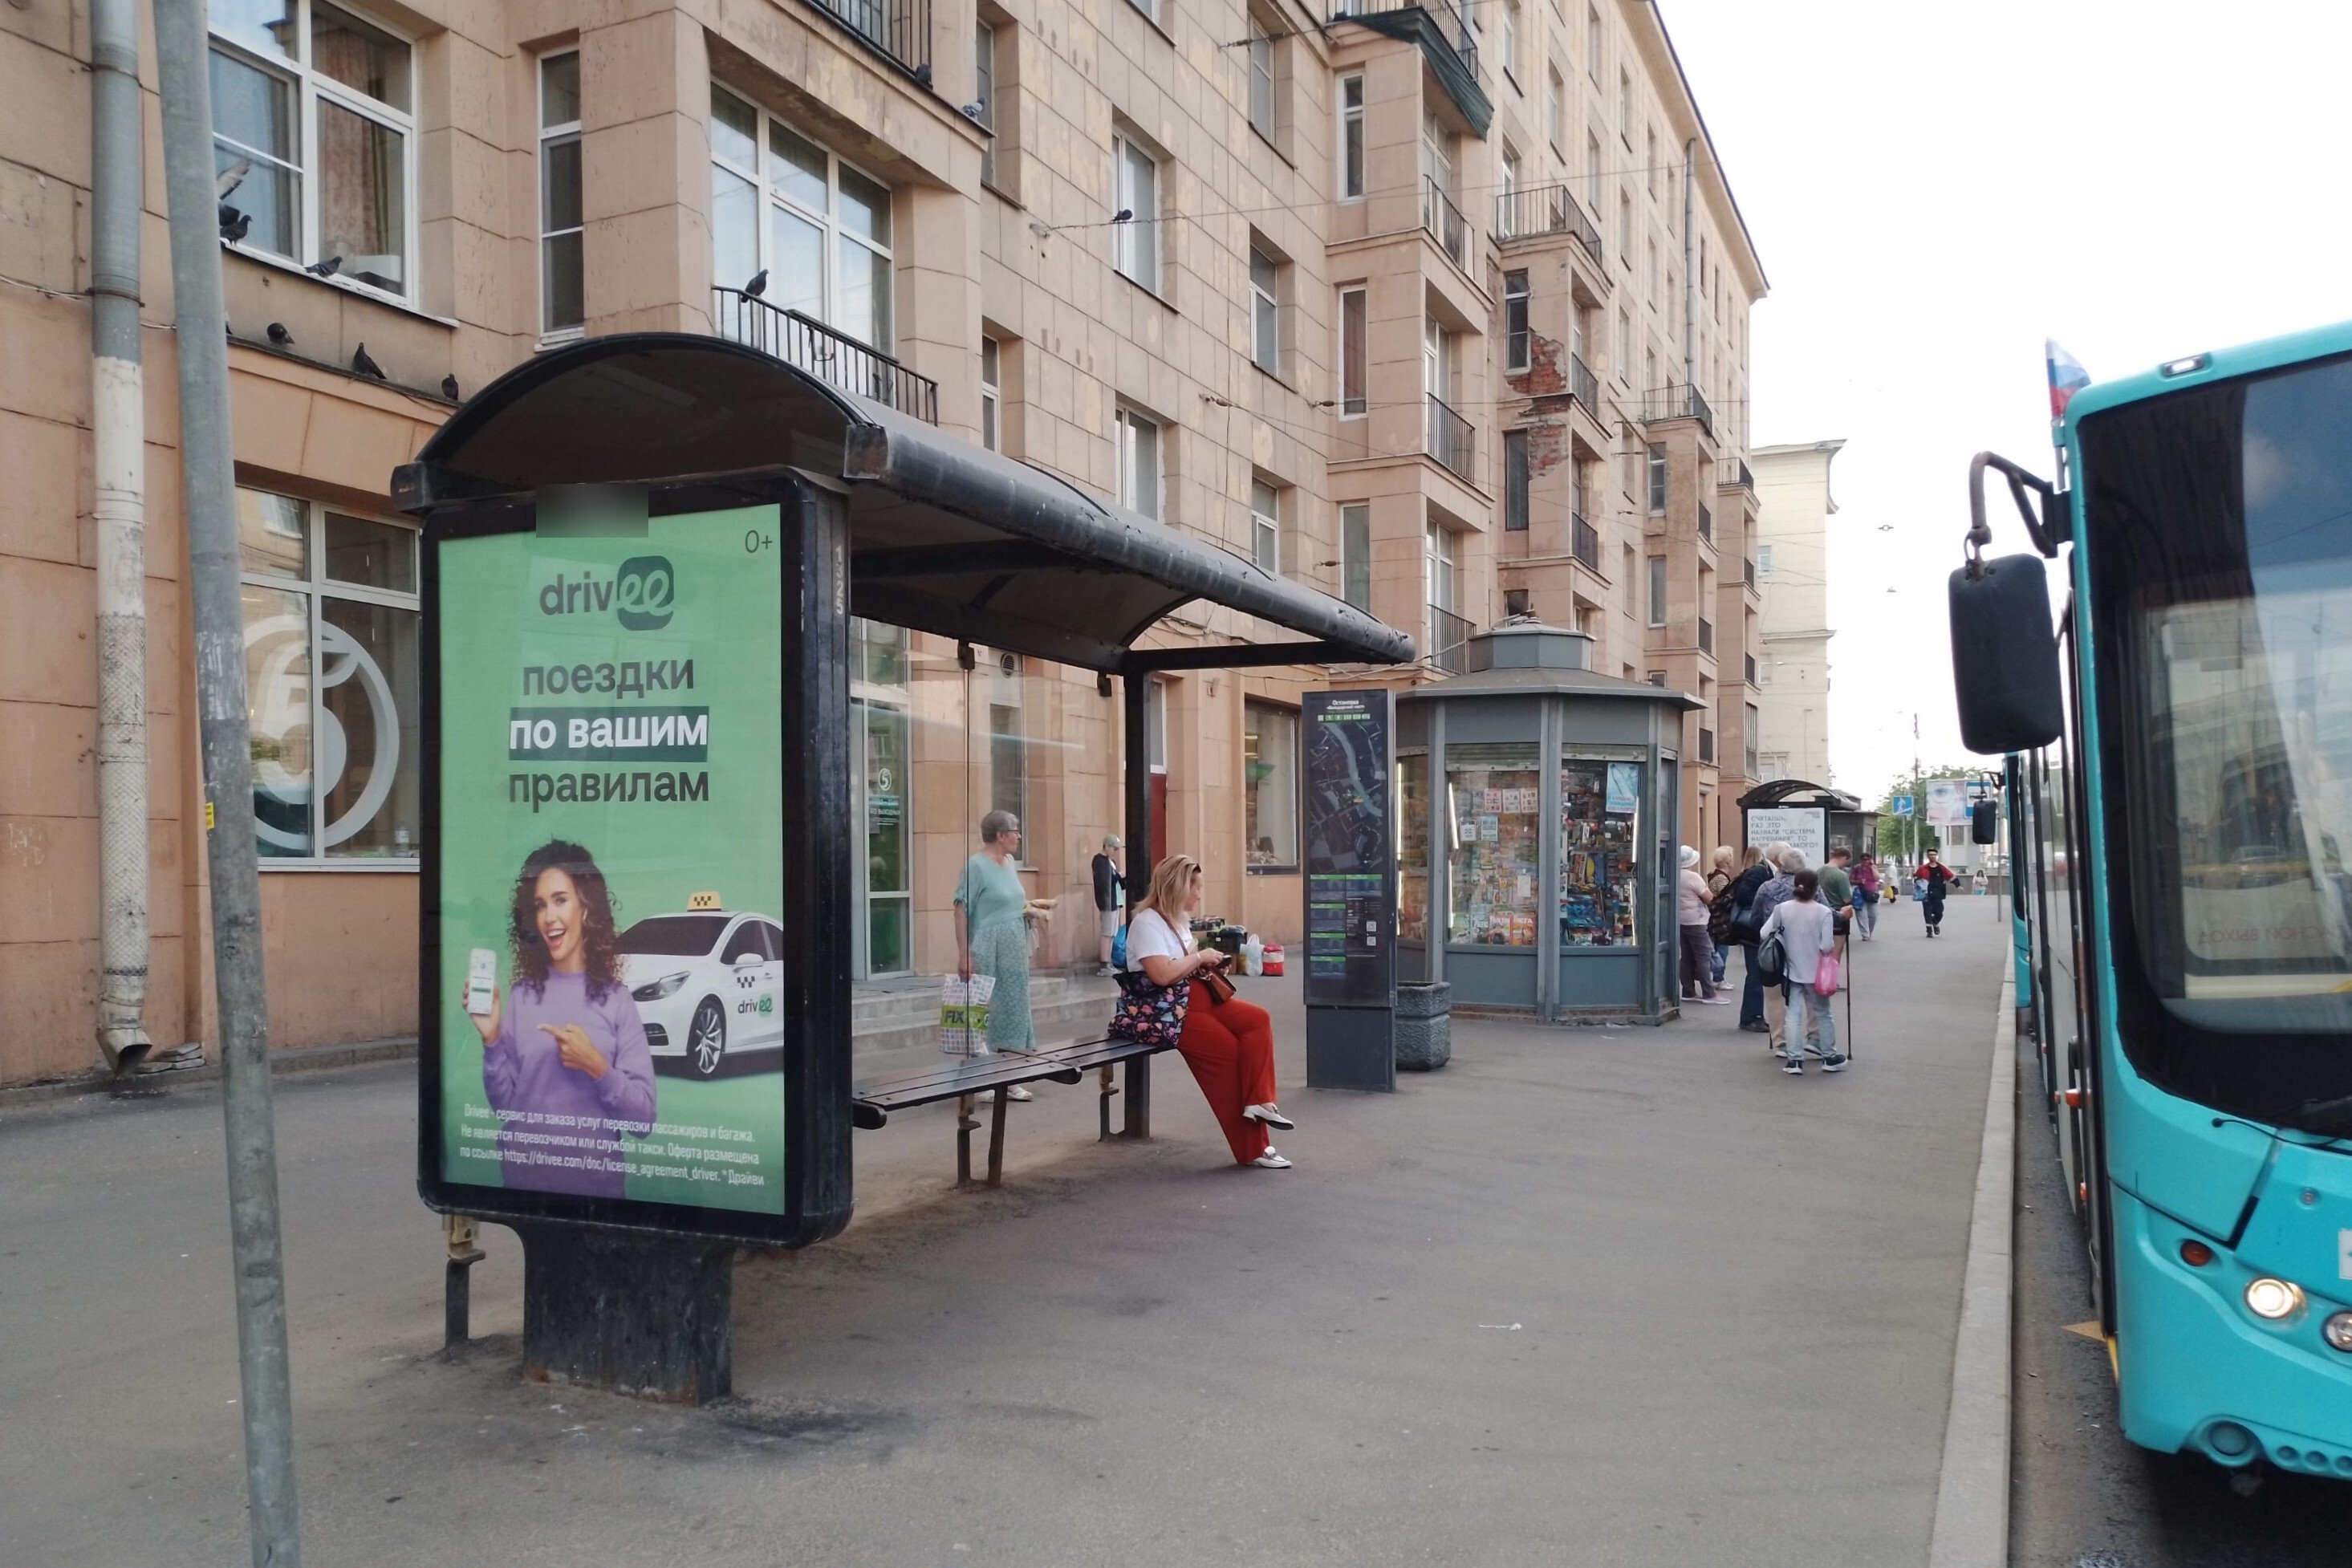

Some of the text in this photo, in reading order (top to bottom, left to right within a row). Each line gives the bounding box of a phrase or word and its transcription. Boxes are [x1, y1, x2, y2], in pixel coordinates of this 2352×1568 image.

[745, 530, 773, 554] 0+
[539, 567, 674, 617] drivee
[523, 659, 693, 699] поездки
[510, 715, 708, 749] по вашим
[510, 771, 709, 813] правилам
[737, 997, 773, 1014] drivee
[944, 1009, 965, 1024] FIX
[496, 1109, 526, 1123] сервис
[526, 1112, 544, 1123] для
[544, 1114, 575, 1126] заказа
[577, 1116, 602, 1131] услуг
[603, 1118, 651, 1132] перевозки
[652, 1123, 708, 1140] пассажиров
[710, 1127, 717, 1139] и
[718, 1126, 755, 1143] багажа.
[460, 1147, 470, 1157] по
[472, 1148, 503, 1160] ссылке
[461, 1123, 759, 1164] Не является перевозчиком или службой такси. Оферта размещена
